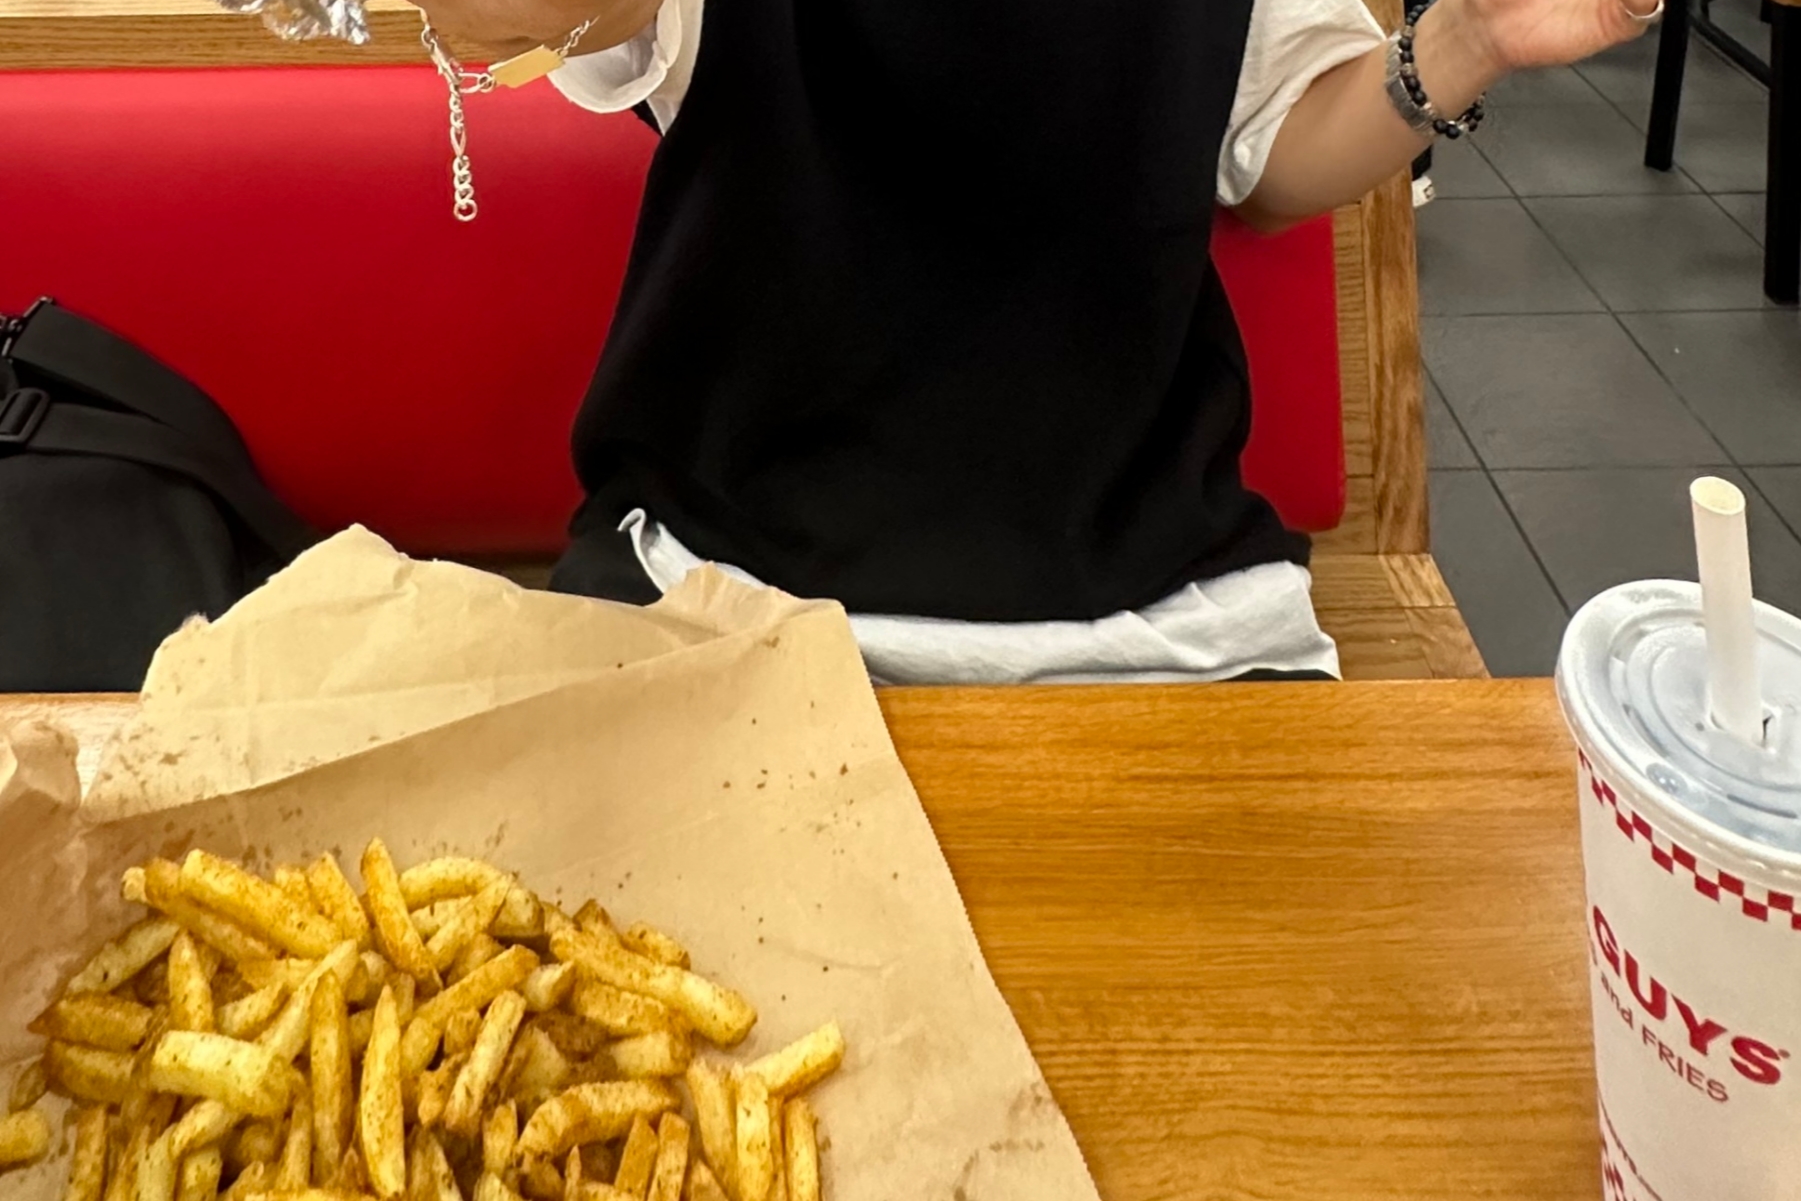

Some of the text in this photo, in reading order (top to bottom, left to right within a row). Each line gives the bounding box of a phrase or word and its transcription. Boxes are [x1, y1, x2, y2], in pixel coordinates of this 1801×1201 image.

[1593, 905, 1781, 1085] GUYS
[1600, 971, 1729, 1103] and FRIES
